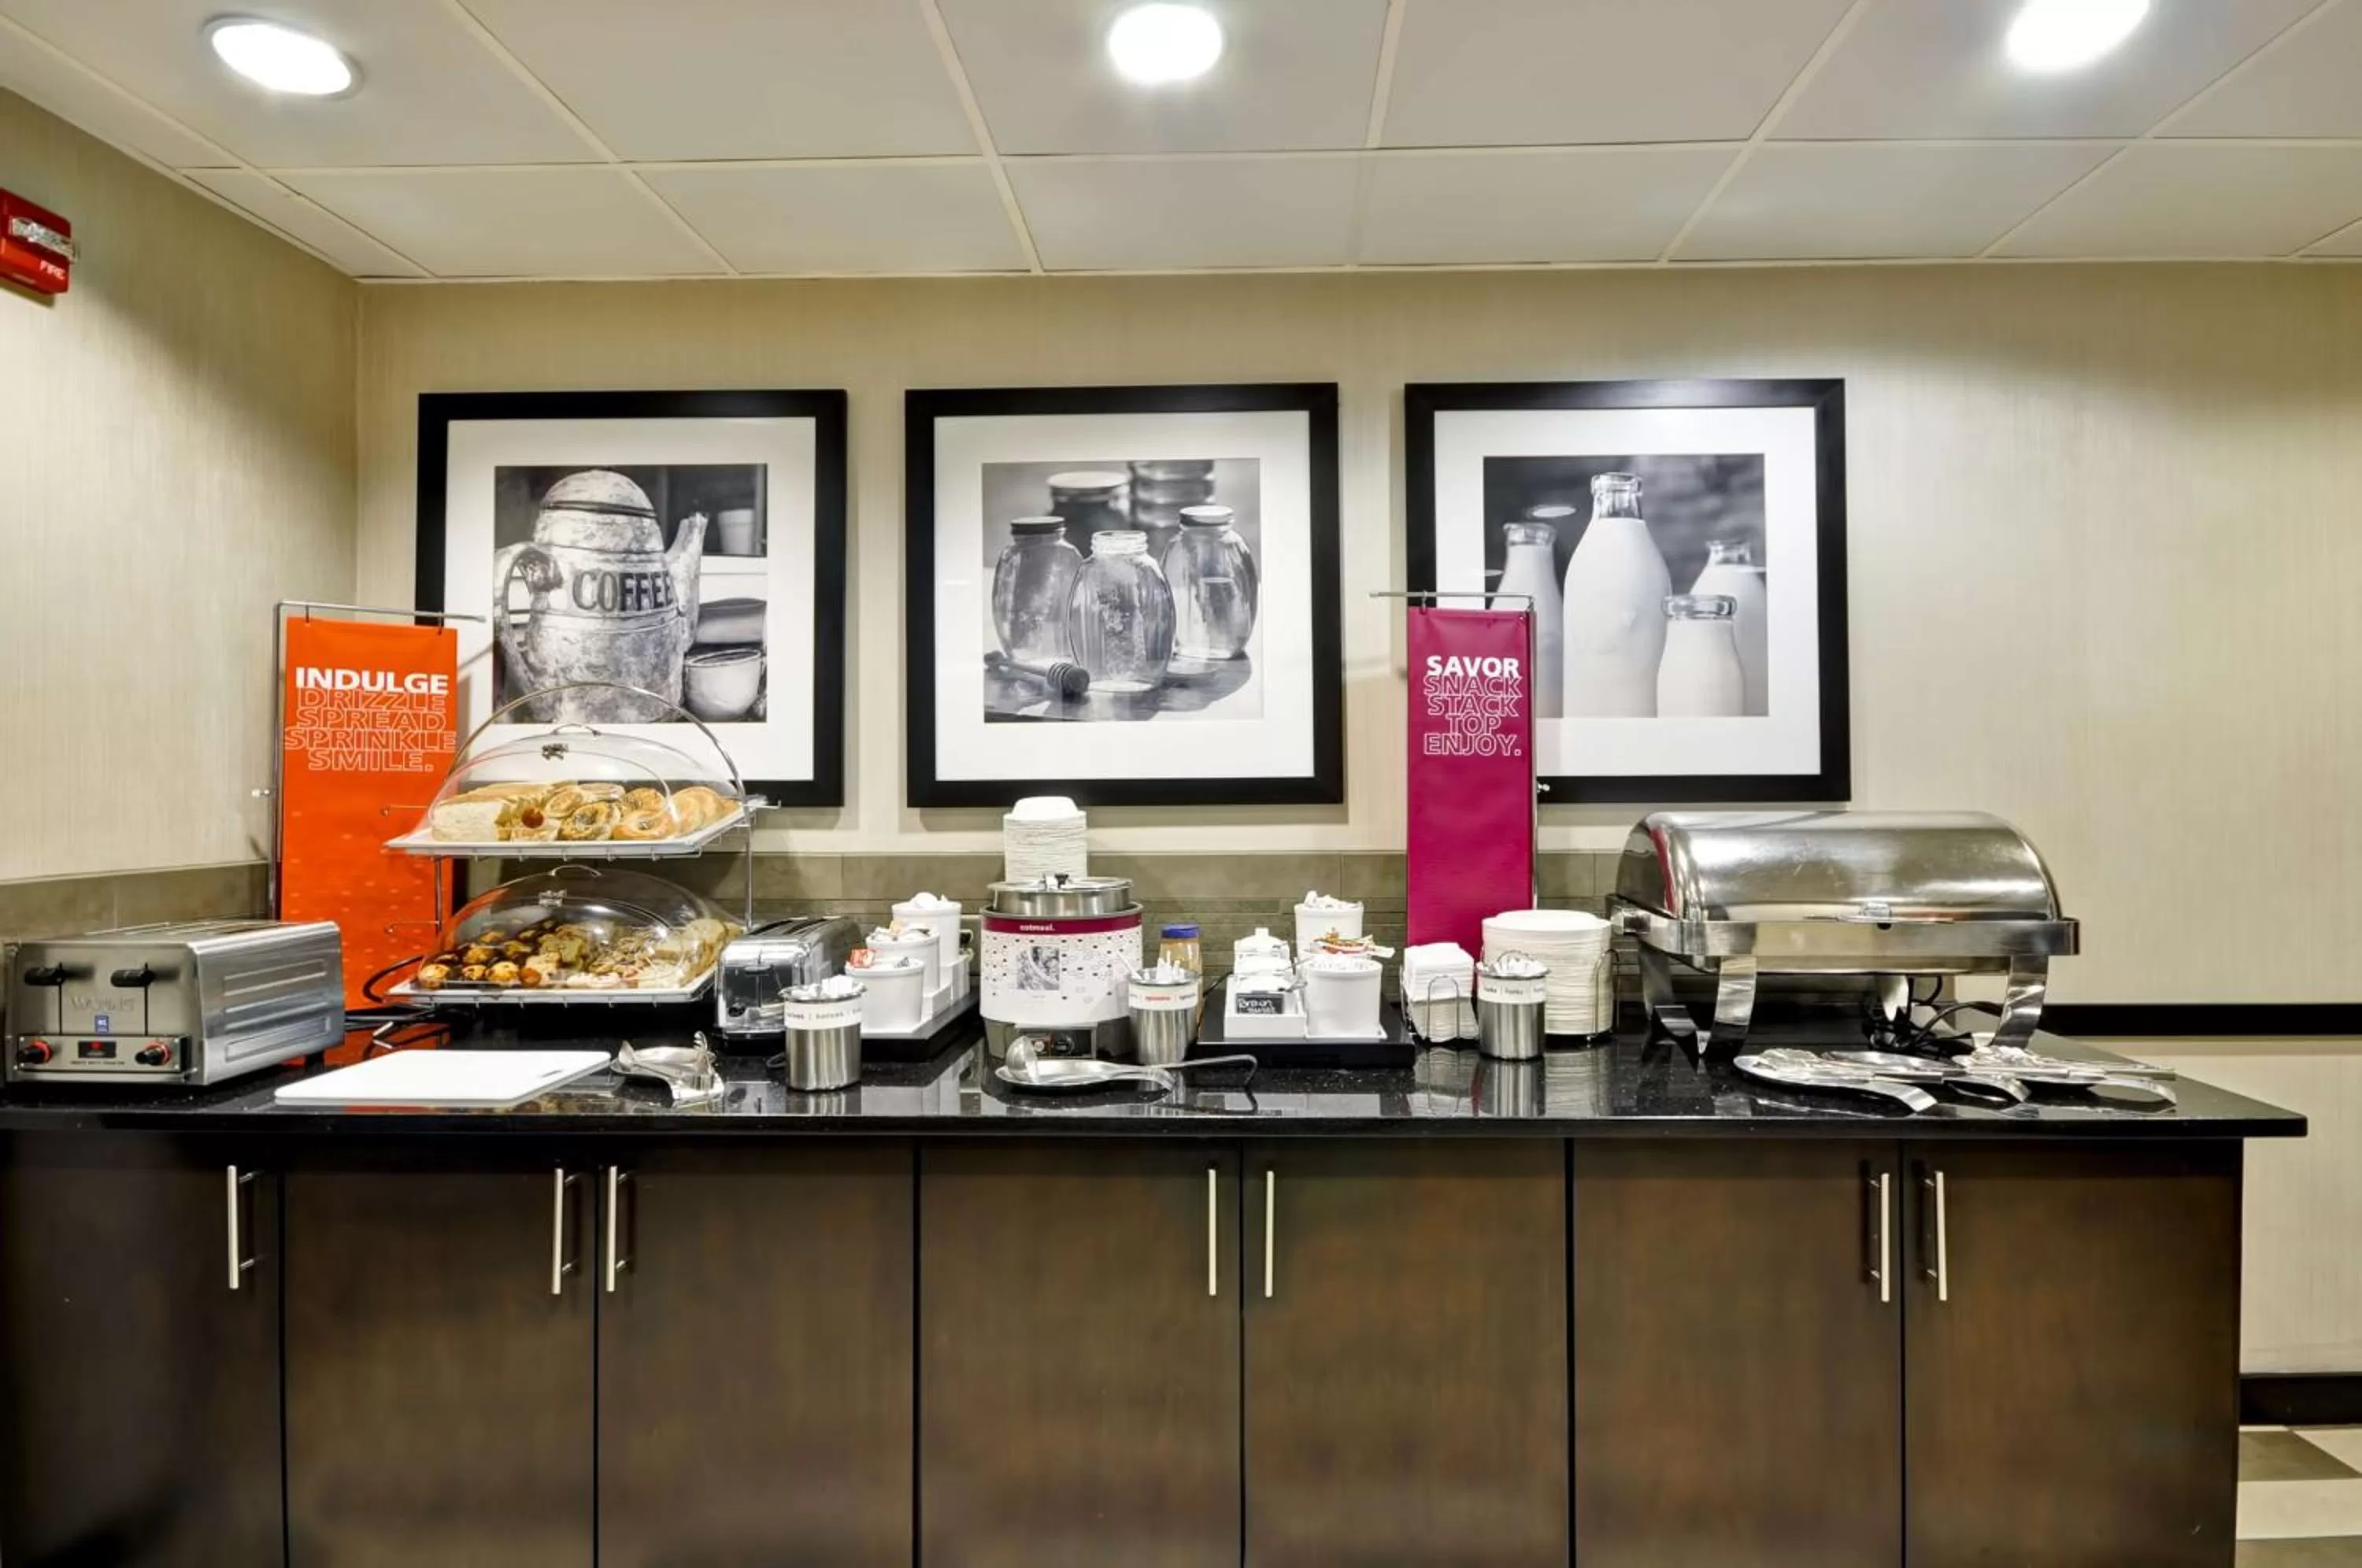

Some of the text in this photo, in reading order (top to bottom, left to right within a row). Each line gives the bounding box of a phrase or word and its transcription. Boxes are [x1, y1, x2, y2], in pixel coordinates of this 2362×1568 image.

[572, 570, 675, 612] COFFEE
[1426, 655, 1520, 678] SAVOR
[295, 667, 449, 694] INDULGE
[1423, 675, 1523, 697] SNACK
[298, 687, 446, 712] DRIZZLE
[1427, 694, 1519, 716] STACK
[296, 708, 446, 731] SPREAD
[1445, 712, 1501, 735] TOP
[284, 726, 457, 753] SPRINKLE
[1423, 732, 1522, 756] ENJOY.
[308, 749, 434, 771] SMILE.
